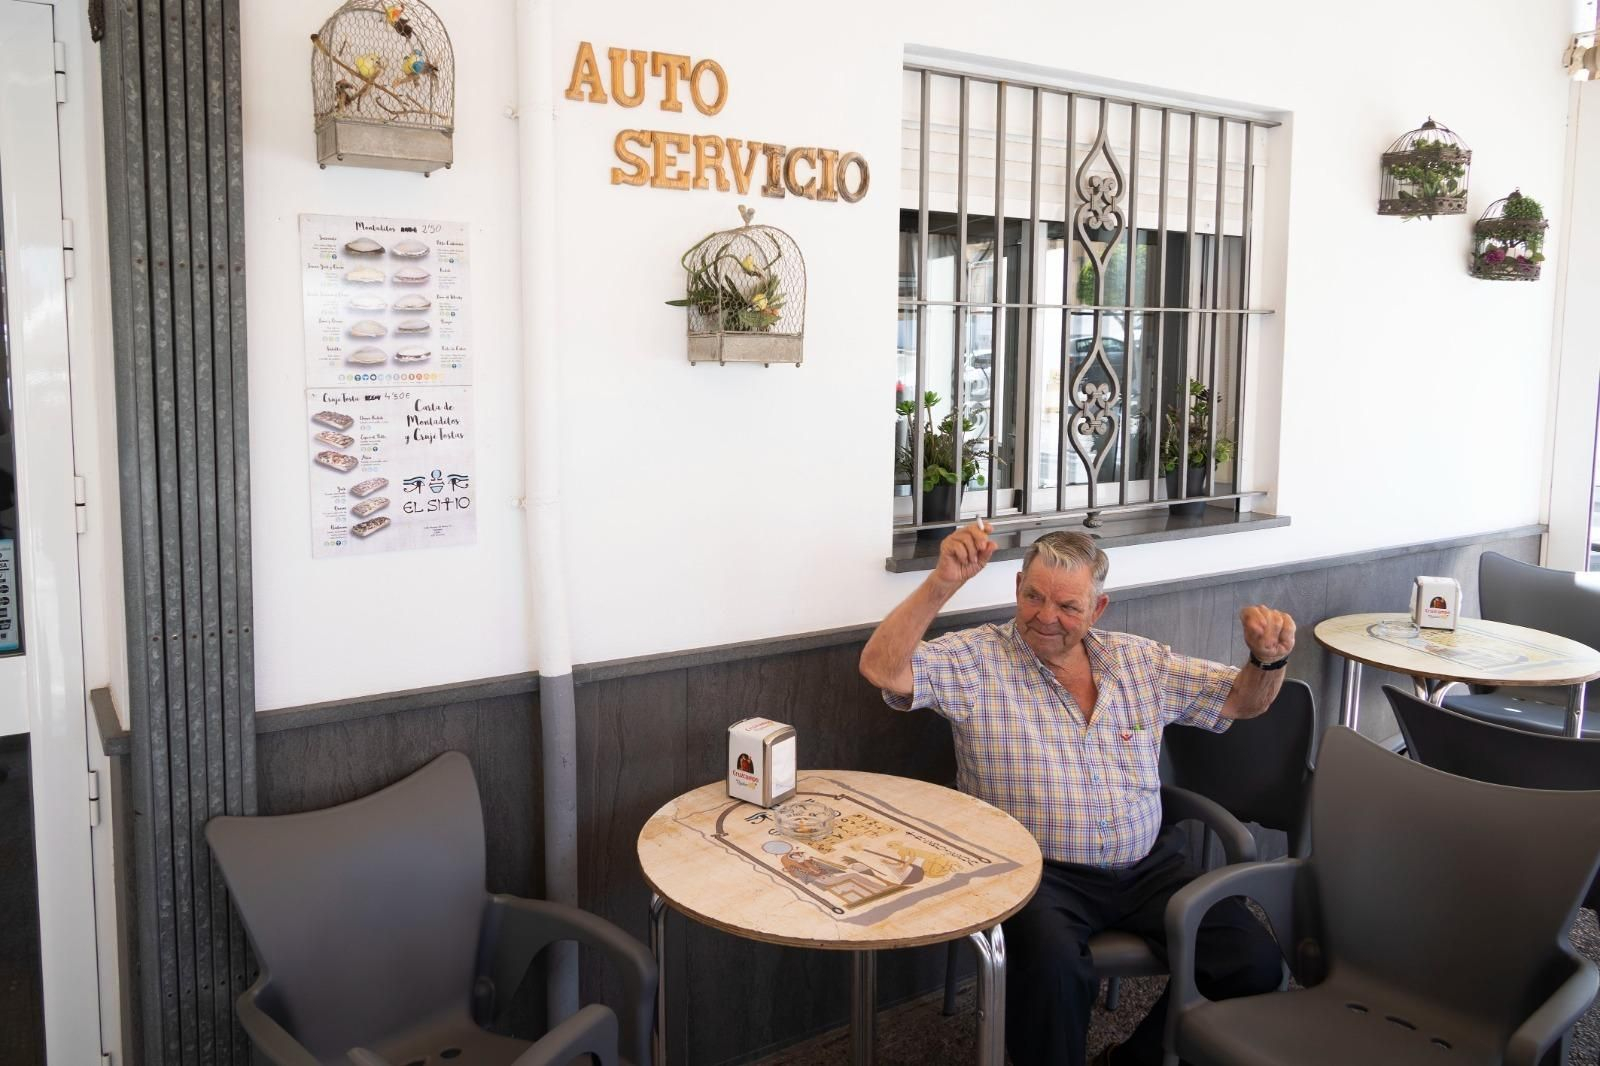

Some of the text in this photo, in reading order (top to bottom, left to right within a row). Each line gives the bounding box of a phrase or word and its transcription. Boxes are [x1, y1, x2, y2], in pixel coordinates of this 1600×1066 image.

[565, 41, 728, 116] AUTO
[610, 129, 870, 203] SERVICIO
[355, 220, 396, 232] Montaditos
[414, 399, 453, 411] Carta de
[406, 414, 460, 427] Montaditos
[404, 435, 410, 445] y
[439, 427, 464, 440] Tostas
[403, 496, 470, 514] EL SITIO
